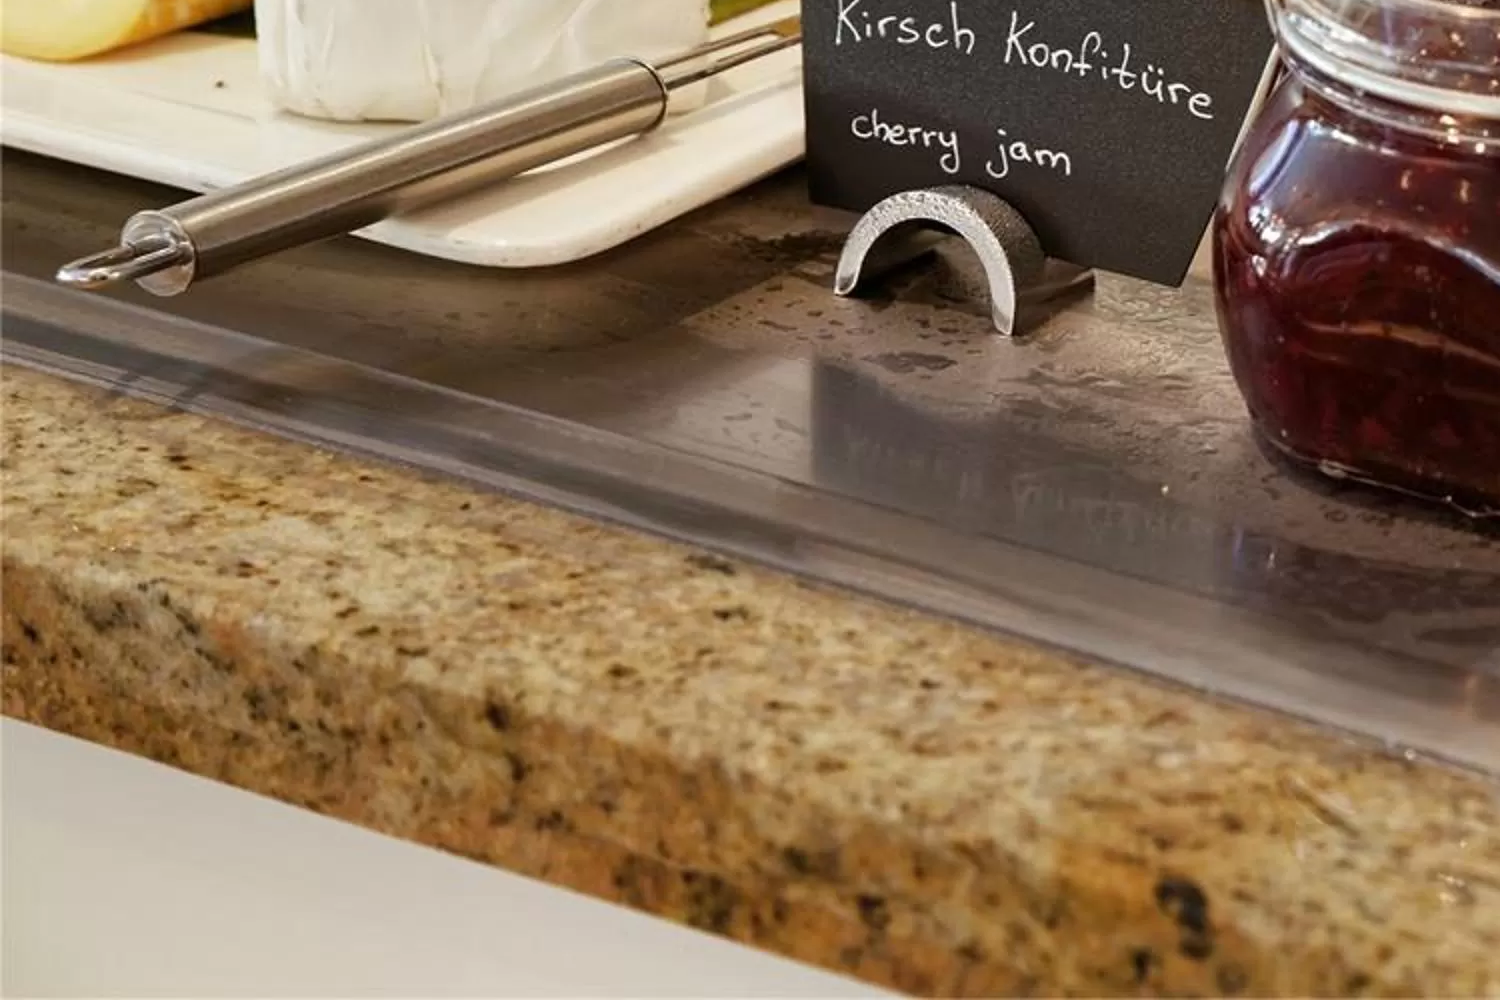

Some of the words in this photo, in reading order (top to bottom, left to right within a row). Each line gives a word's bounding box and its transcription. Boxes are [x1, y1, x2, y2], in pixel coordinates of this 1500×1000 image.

[1004, 11, 1214, 119] Konfitüre
[851, 109, 961, 174] cherry
[985, 129, 1072, 179] jam
